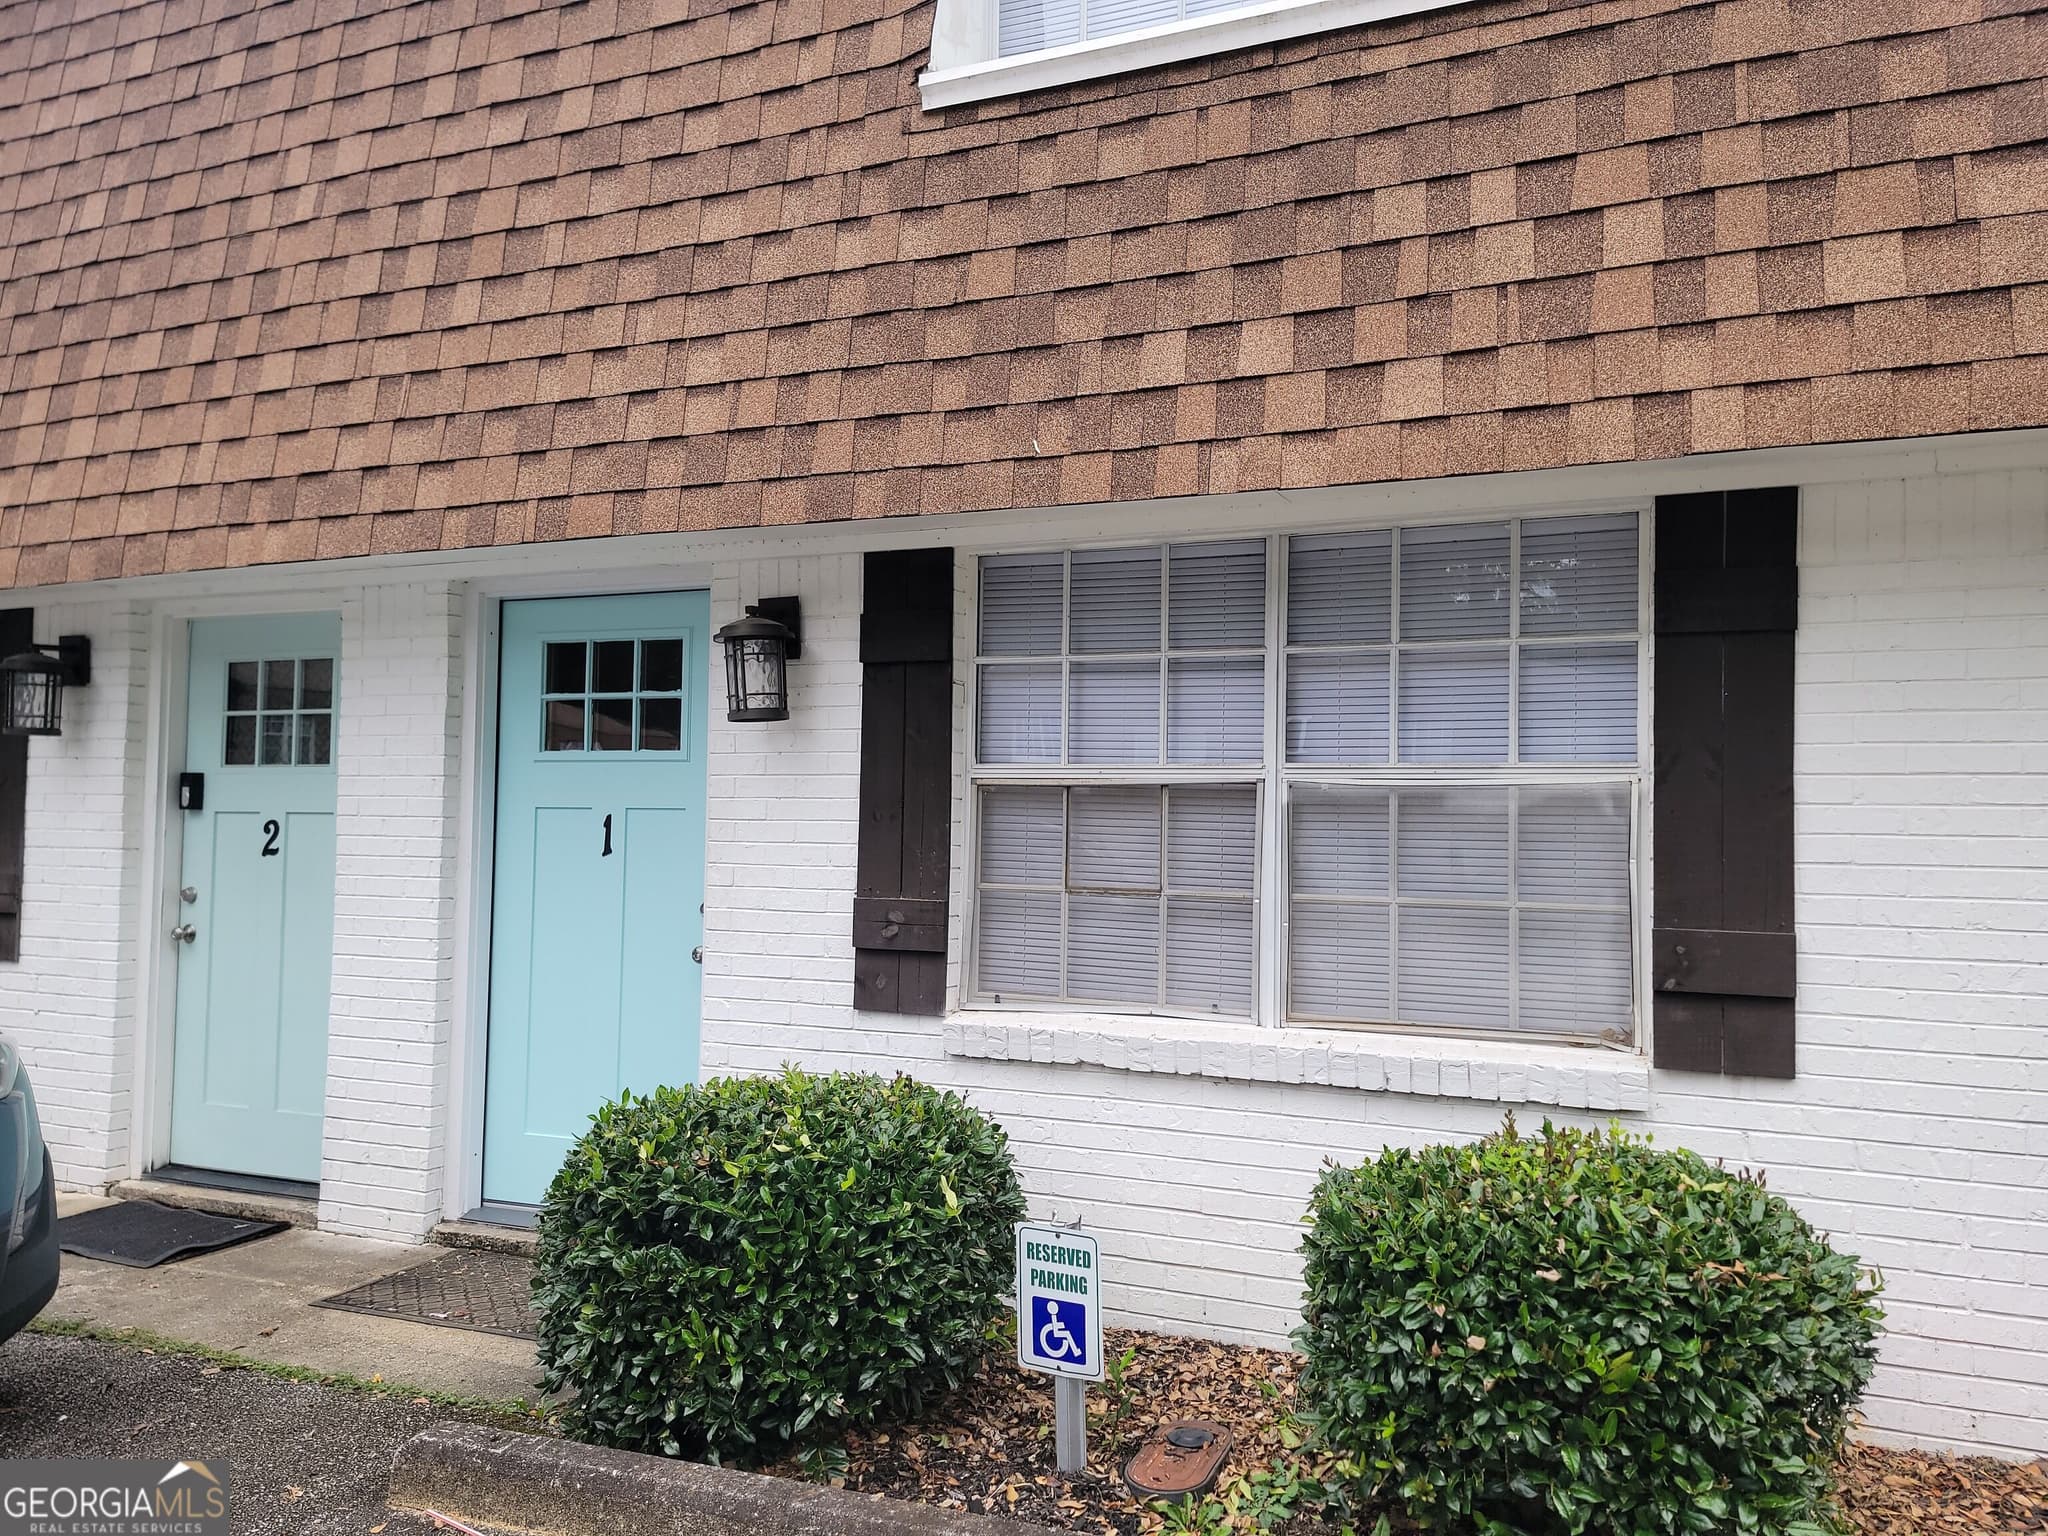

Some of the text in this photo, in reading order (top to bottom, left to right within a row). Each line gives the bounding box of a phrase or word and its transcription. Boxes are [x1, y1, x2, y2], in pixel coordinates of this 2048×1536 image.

[261, 819, 280, 857] 2
[602, 813, 613, 857] 1
[1026, 1241, 1091, 1269] RESERVED
[1030, 1268, 1088, 1295] PARKING
